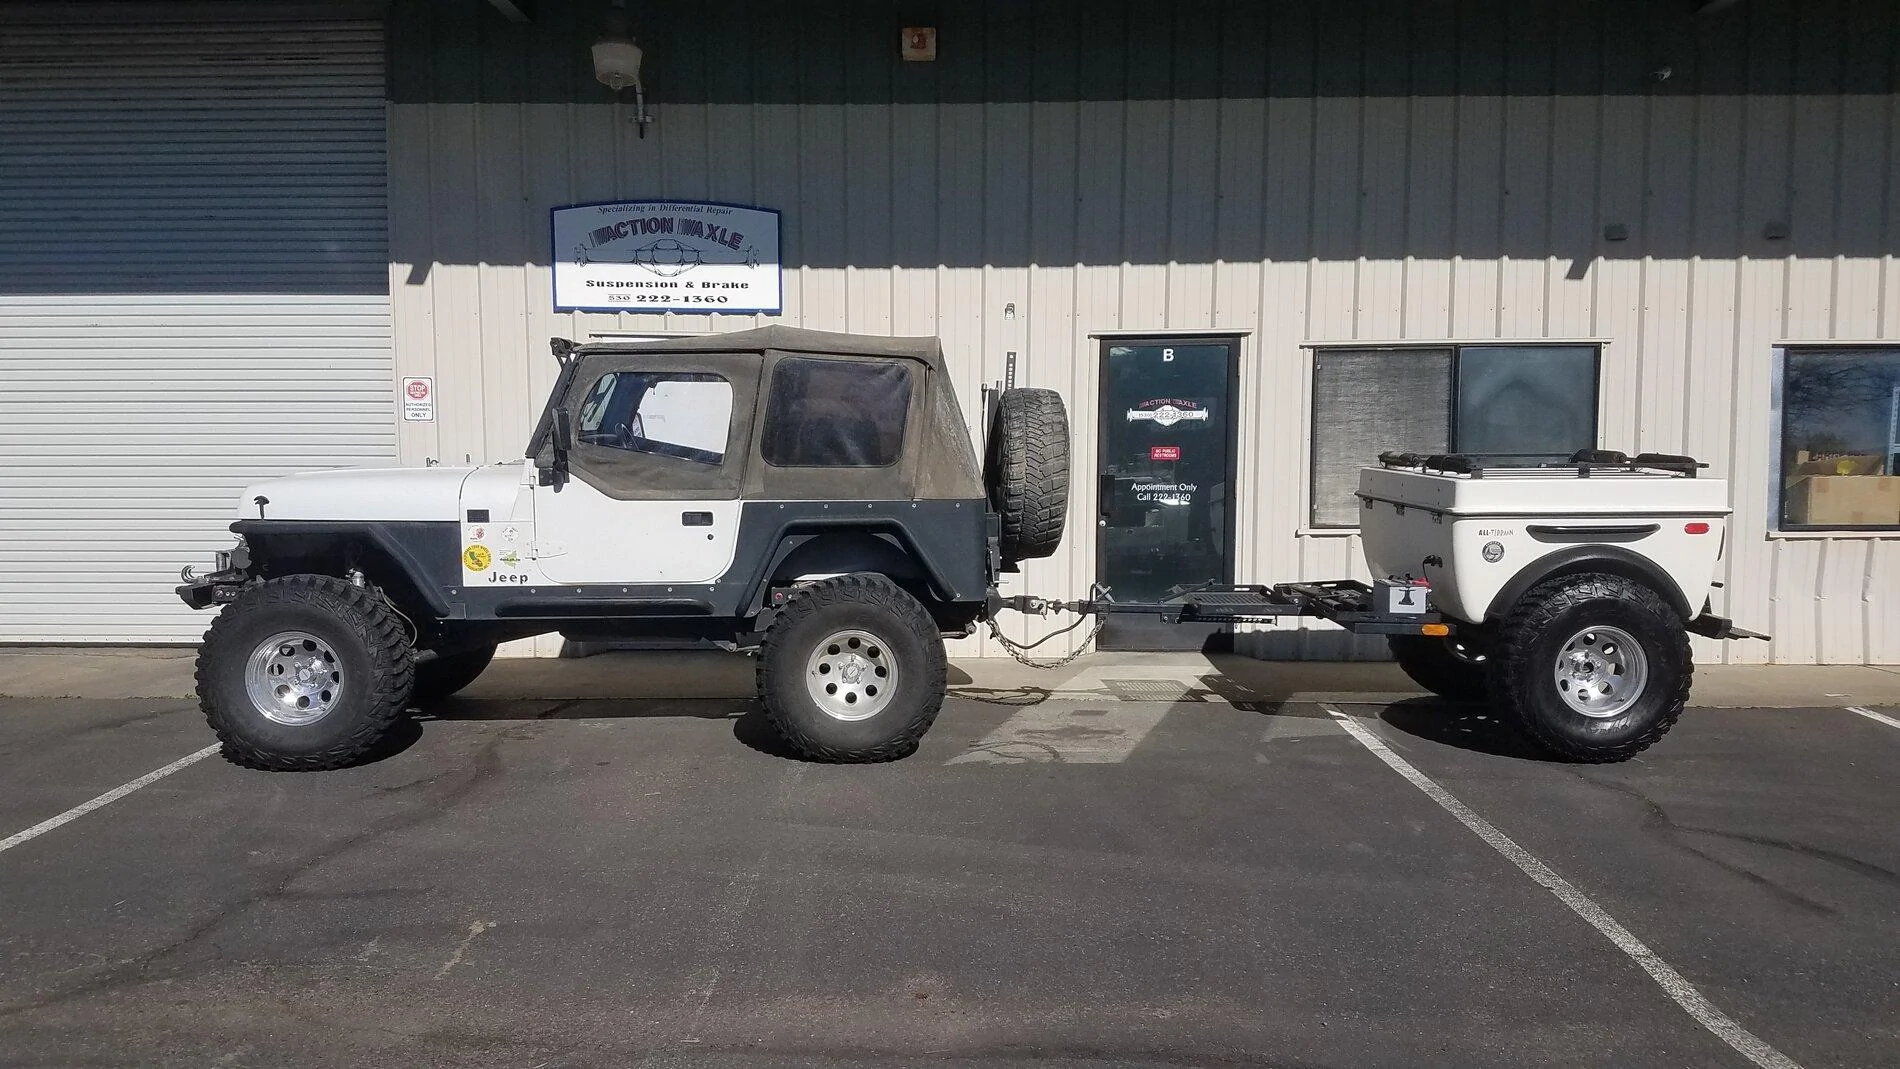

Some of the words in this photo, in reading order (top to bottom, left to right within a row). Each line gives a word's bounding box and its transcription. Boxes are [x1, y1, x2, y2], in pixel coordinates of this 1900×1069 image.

[598, 204, 645, 215] Specializing
[648, 203, 656, 212] in
[659, 204, 704, 213] Differential
[706, 205, 734, 216] Repair
[594, 217, 674, 246] ACTION
[684, 218, 745, 251] AXLE
[585, 279, 678, 289] Suspension
[685, 280, 695, 289] &
[701, 280, 749, 289] Brake
[636, 294, 728, 303] 222-1360
[1162, 348, 1175, 362] B
[1142, 397, 1171, 407] ACTION
[1176, 399, 1198, 409] AXLE
[1131, 482, 1178, 492] Appointment
[1178, 482, 1198, 493] Only
[1136, 492, 1151, 501] Call
[1152, 492, 1191, 501] 222-1360
[488, 571, 528, 585] Jeep
